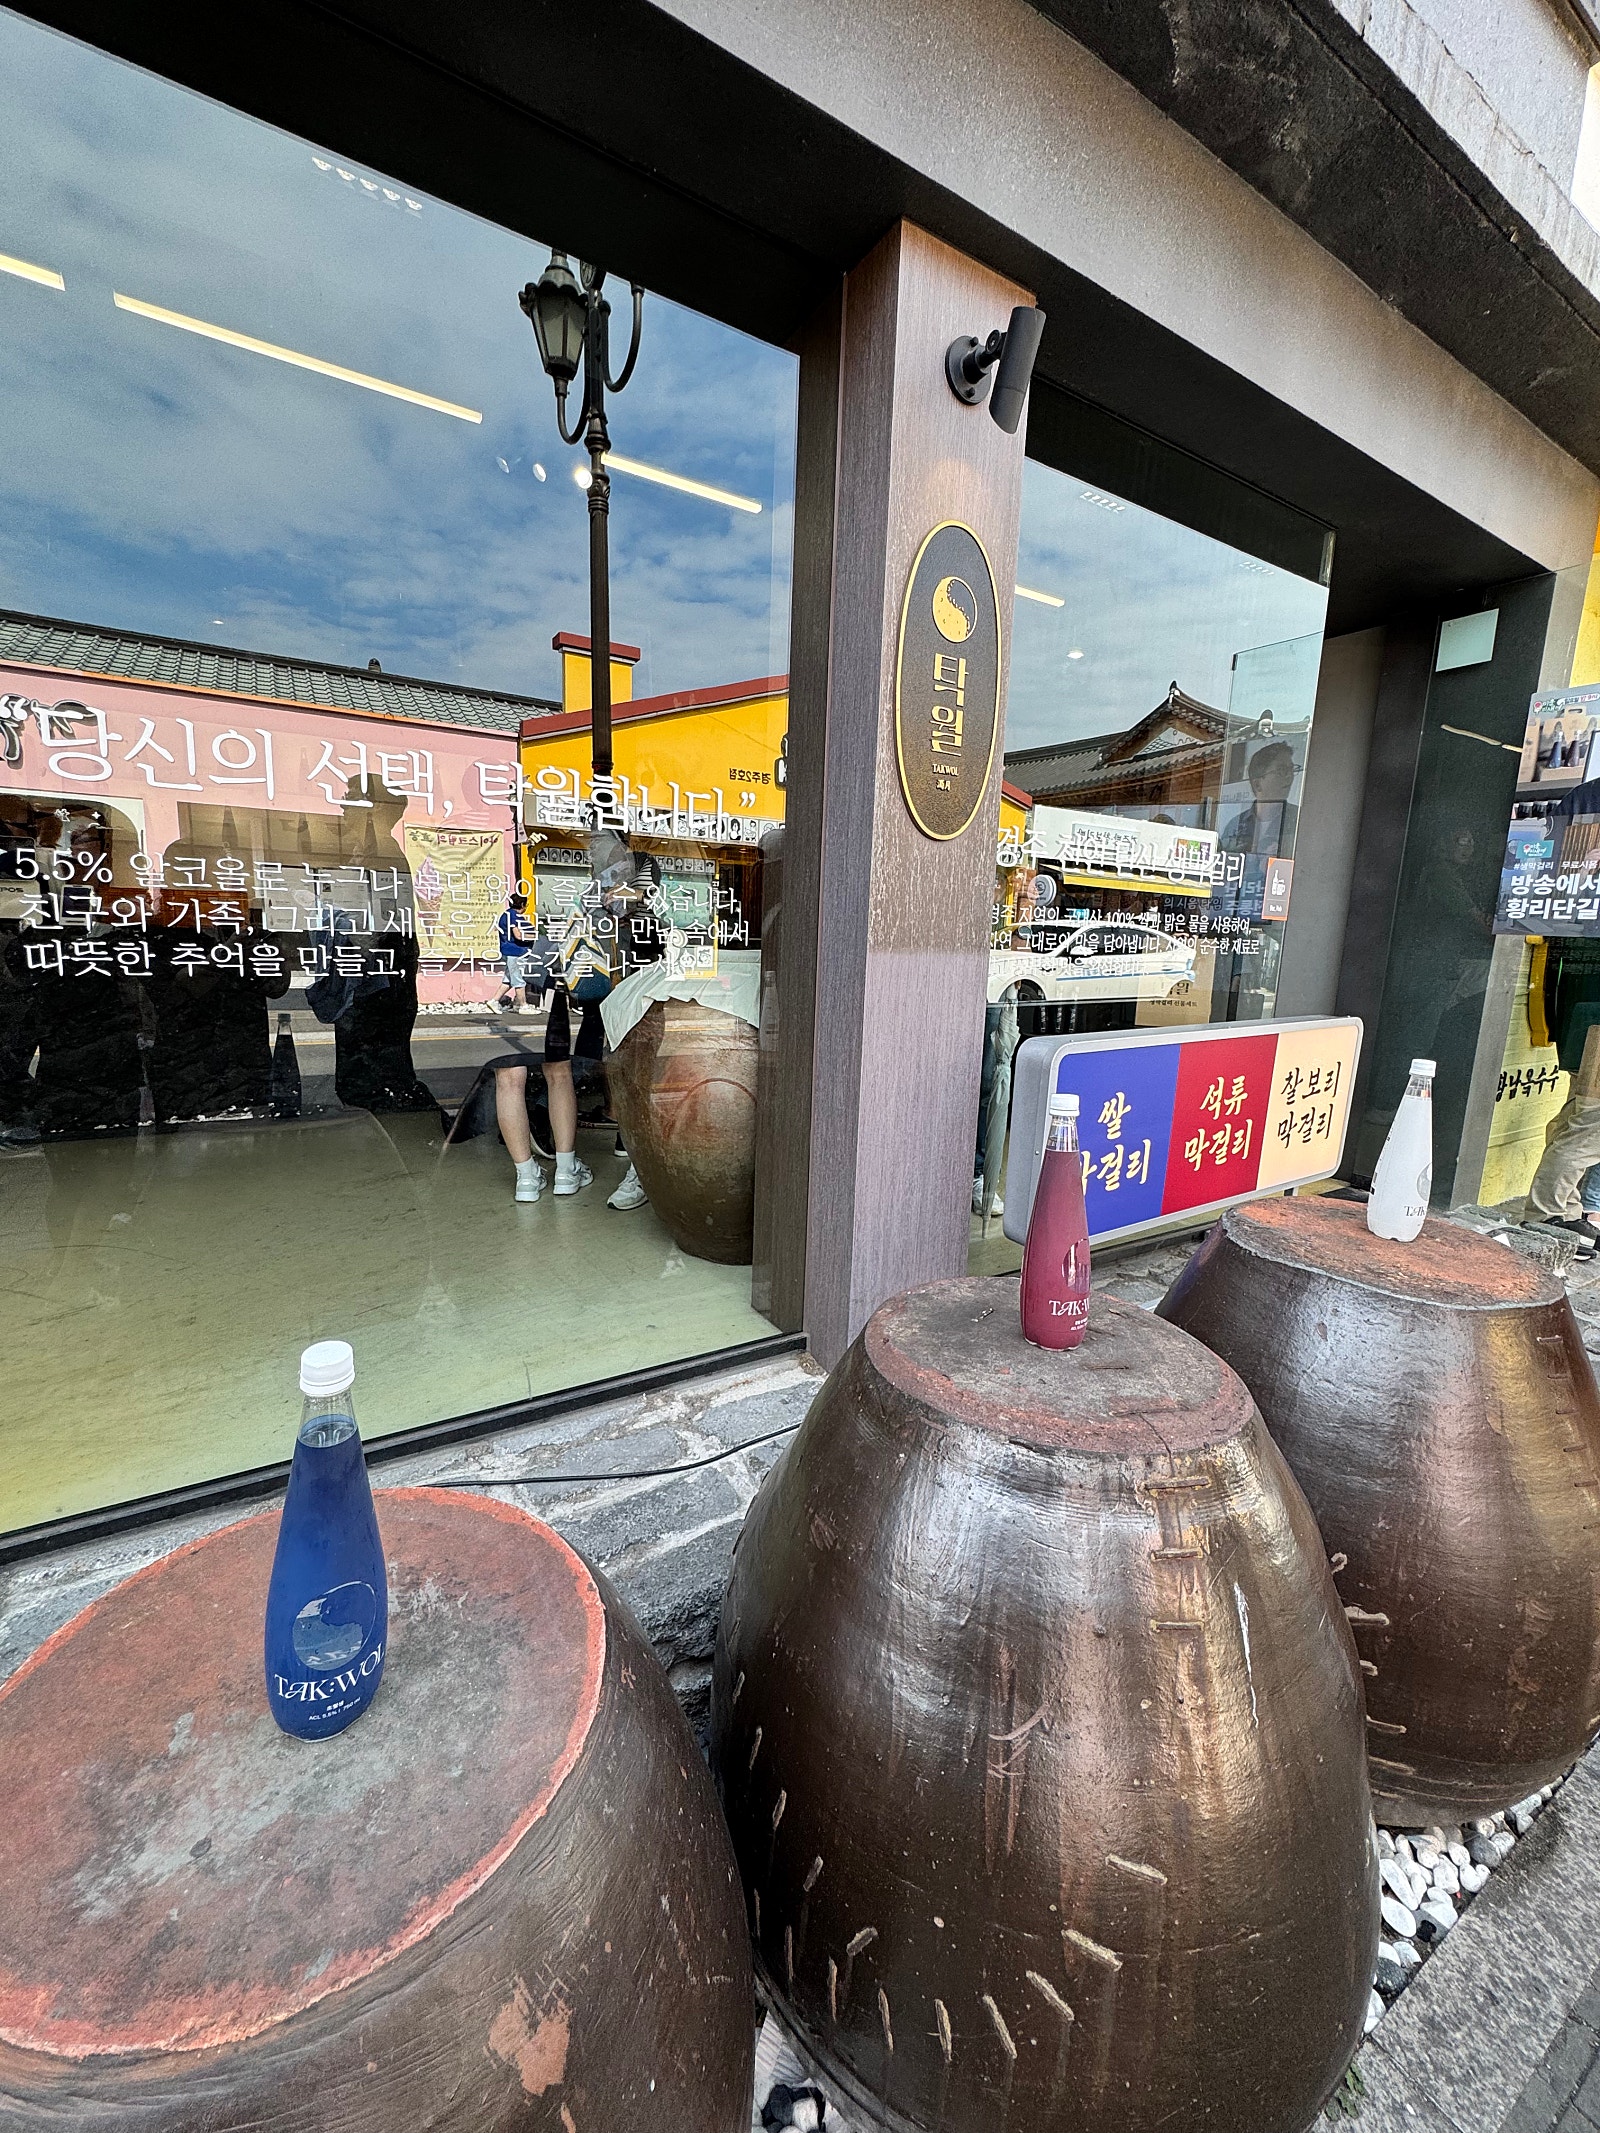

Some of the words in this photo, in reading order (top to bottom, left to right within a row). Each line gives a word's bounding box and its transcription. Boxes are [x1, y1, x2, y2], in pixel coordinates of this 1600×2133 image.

[931, 652, 969, 758] 탁월
[306, 740, 454, 818] 선택,
[932, 763, 959, 777] TAKWOL
[996, 825, 1048, 870] 경주
[1513, 860, 1554, 871] #생막걸리
[1561, 860, 1598, 869] 무료시음
[15, 848, 113, 884] 5.5%
[130, 851, 289, 892] 알코올로
[414, 869, 475, 902] 부담
[486, 873, 539, 906] 없이
[551, 877, 603, 908] 즐길
[612, 881, 638, 910] 수
[1511, 873, 1600, 895] 방송에서
[18, 892, 153, 933] 친구와
[167, 897, 254, 935] 가족,
[267, 902, 373, 938] 그리고
[383, 905, 476, 940] 새로운
[486, 911, 619, 943] 사람들과의
[685, 919, 749, 946] 속에서
[1164, 912, 1186, 932] 맑은
[1188, 914, 1209, 933] 물을
[1211, 915, 1251, 935] 사용하여,
[1506, 897, 1600, 920] 황리단길
[24, 939, 156, 977] 따뜻한
[170, 942, 285, 977] 추억을
[299, 943, 406, 980] 만들고,
[417, 948, 507, 978] 즐거운
[516, 948, 598, 978] 순간을
[1104, 932, 1162, 954] 담아냅니다.
[1200, 937, 1230, 955] 순수한
[1231, 938, 1260, 955] 재료로
[1199, 1074, 1248, 1120] 석류
[1280, 1061, 1342, 1105] 찰보리
[1097, 1091, 1132, 1140] 쌀
[1277, 1103, 1335, 1149] 막걸리
[1184, 1119, 1254, 1171] 막걸리
[274, 1641, 385, 1702] TAK:WOL
